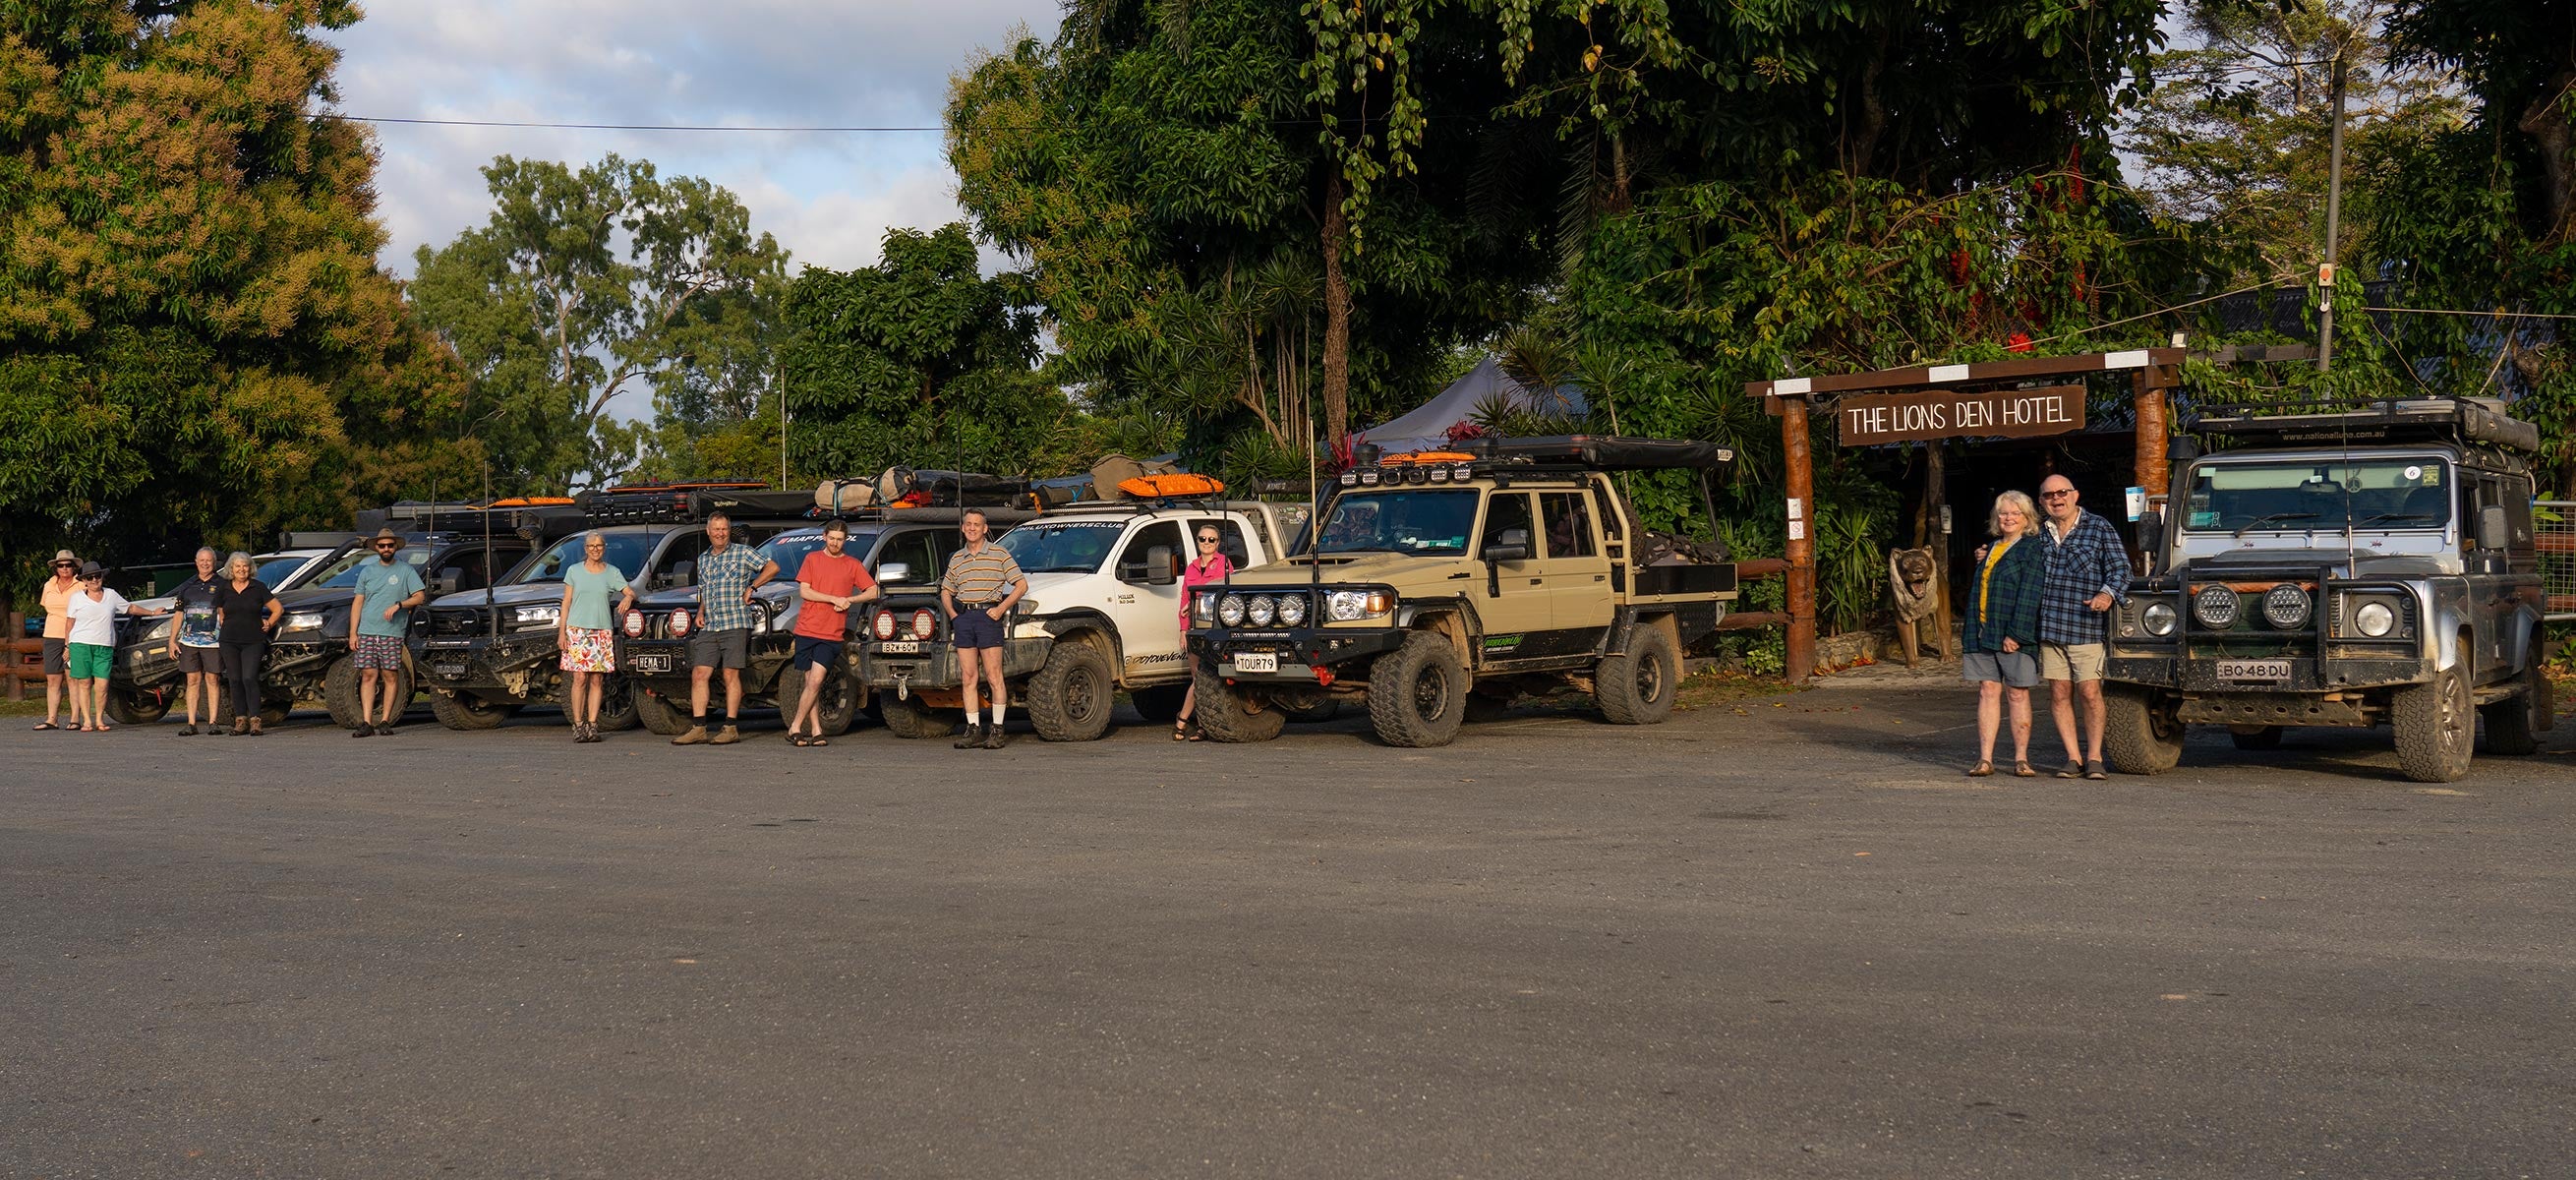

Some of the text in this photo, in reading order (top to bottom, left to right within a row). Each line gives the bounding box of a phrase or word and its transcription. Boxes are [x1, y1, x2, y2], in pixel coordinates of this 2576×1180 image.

[1847, 395, 2072, 434] THE LIONS DEN HOTEL
[1240, 658, 1273, 670] TOUR79
